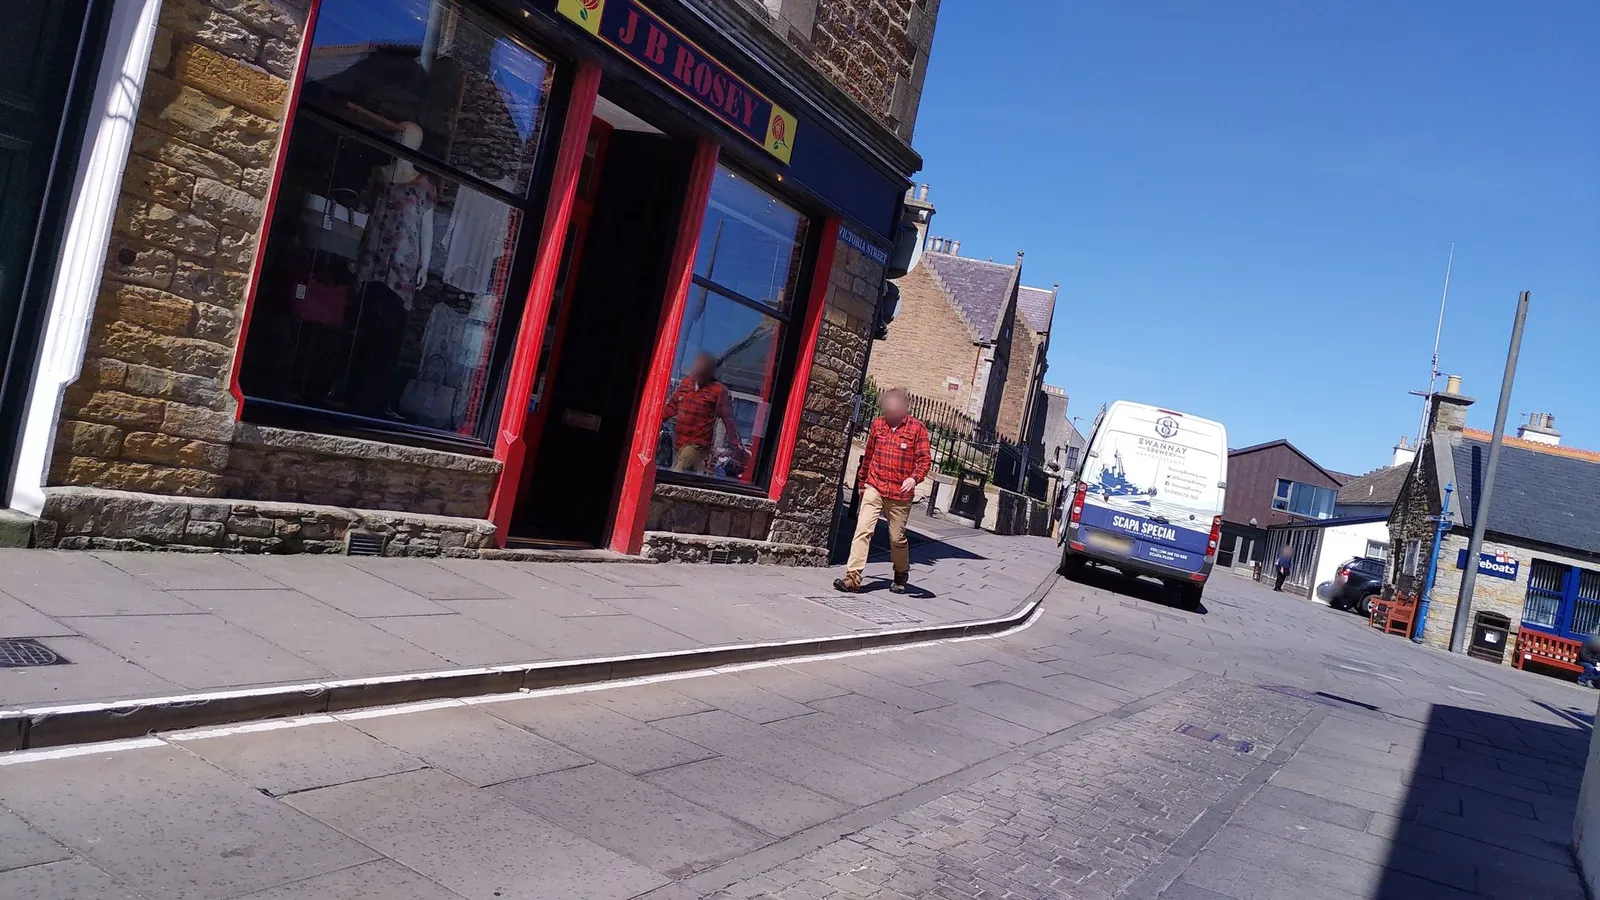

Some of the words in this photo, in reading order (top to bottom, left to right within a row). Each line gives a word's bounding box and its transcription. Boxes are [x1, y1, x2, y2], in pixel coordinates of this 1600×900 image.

[619, 8, 642, 45] J
[643, 20, 669, 65] B
[671, 44, 760, 129] ROSEY
[839, 226, 867, 251] VICTORIA
[864, 238, 888, 265] STREET
[1138, 437, 1188, 455] SWANNAY
[1146, 446, 1177, 458] BREWERY
[1112, 515, 1140, 532] SCAPA
[1141, 522, 1176, 541] SPECIAL
[1479, 559, 1515, 574] eboats
